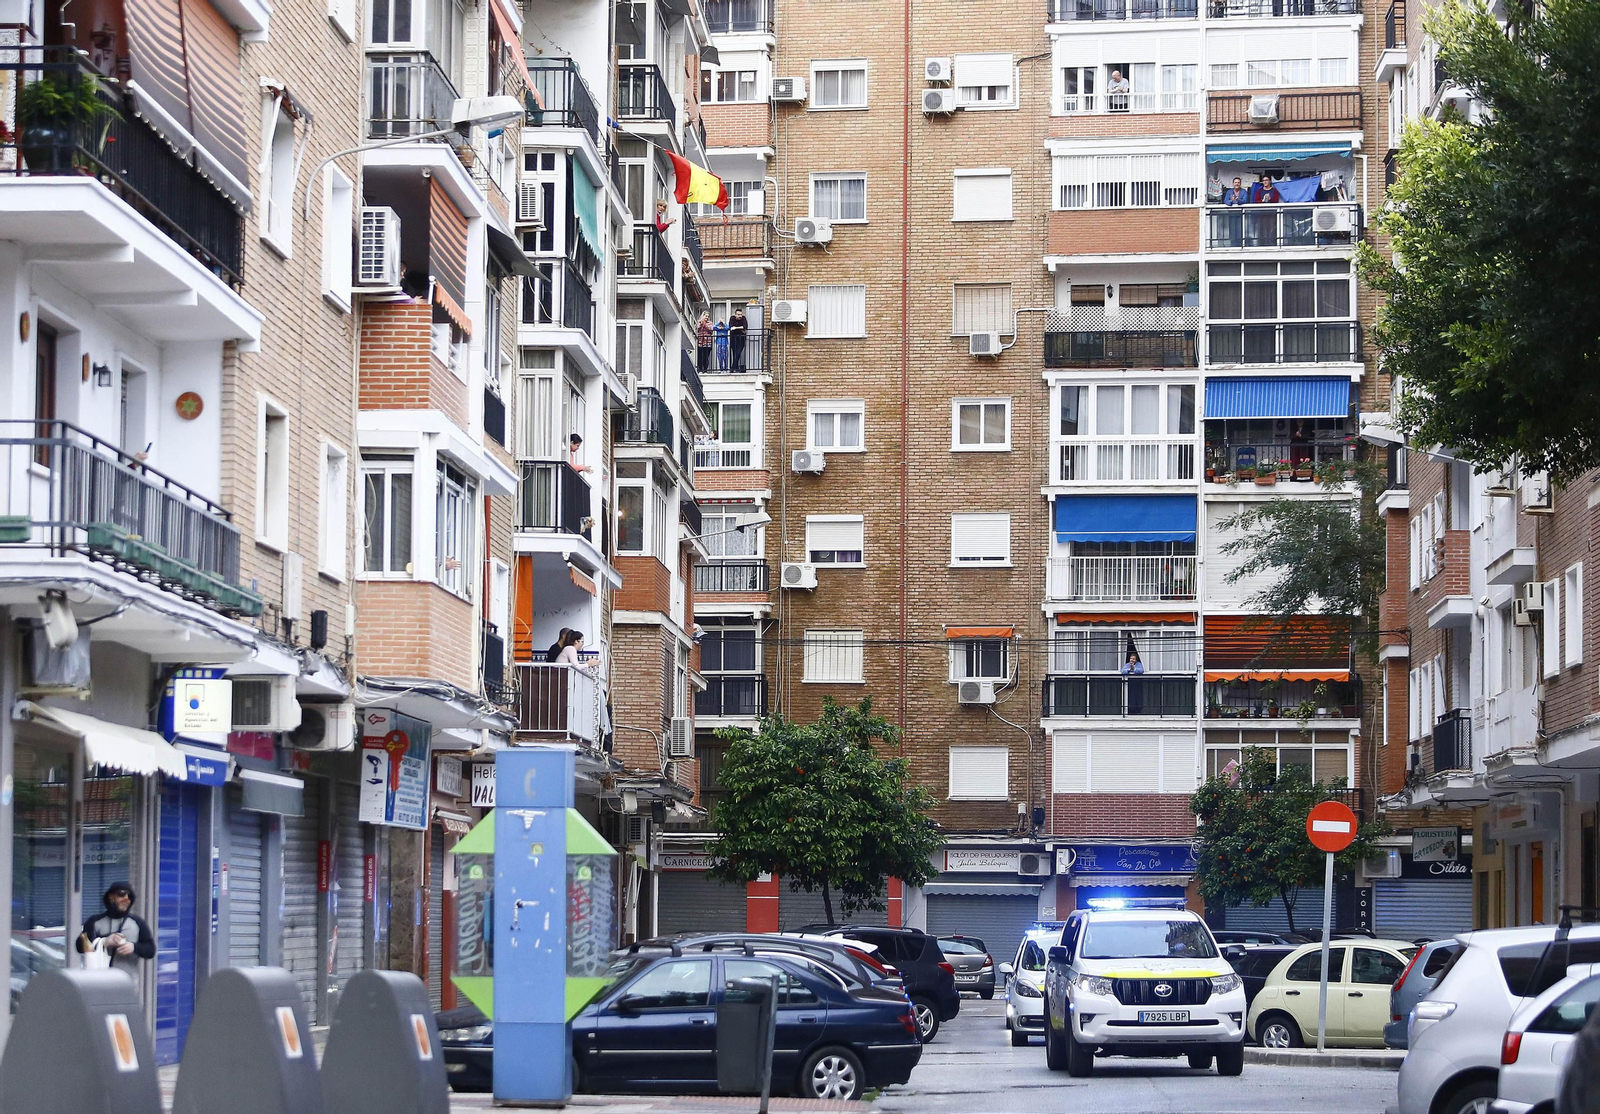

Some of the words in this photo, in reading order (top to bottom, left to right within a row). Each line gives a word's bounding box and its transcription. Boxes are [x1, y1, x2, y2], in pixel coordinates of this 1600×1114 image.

[1429, 861, 1467, 875] Silvia
[1145, 1012, 1167, 1021] 7925
[1170, 1012, 1187, 1021] LBP
